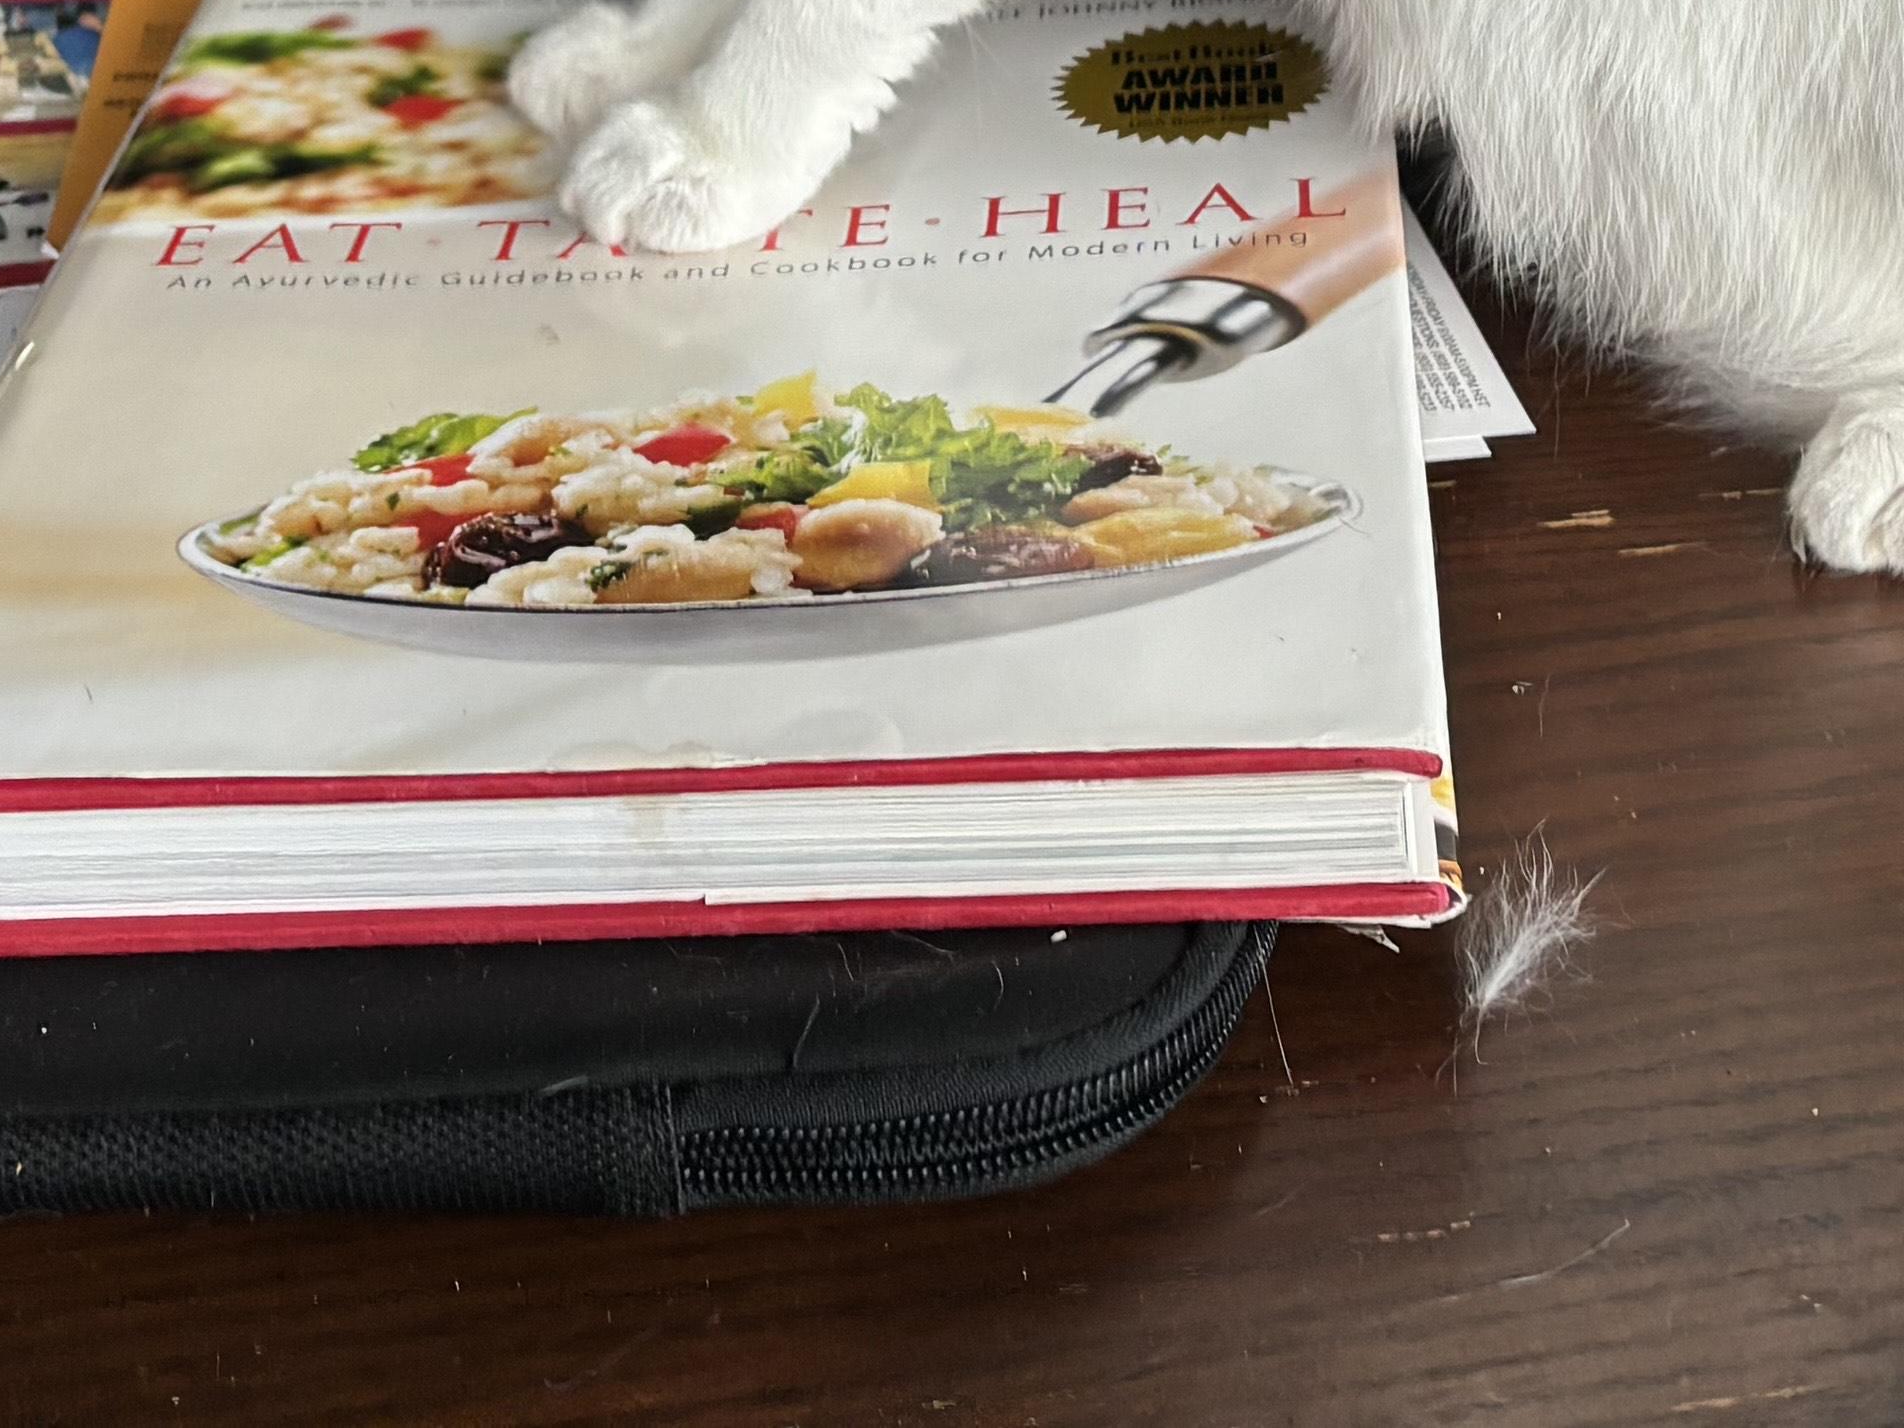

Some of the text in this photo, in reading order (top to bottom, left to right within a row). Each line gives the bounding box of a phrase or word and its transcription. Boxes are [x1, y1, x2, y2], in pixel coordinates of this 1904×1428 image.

[1112, 82, 1284, 114] WINNER
[1120, 60, 1278, 90] AWARD
[154, 222, 402, 267] EAT
[980, 176, 1347, 238] HEAL
[165, 228, 1308, 291] An Ayurvedic Guidebook and Cookbook for Modern Living
